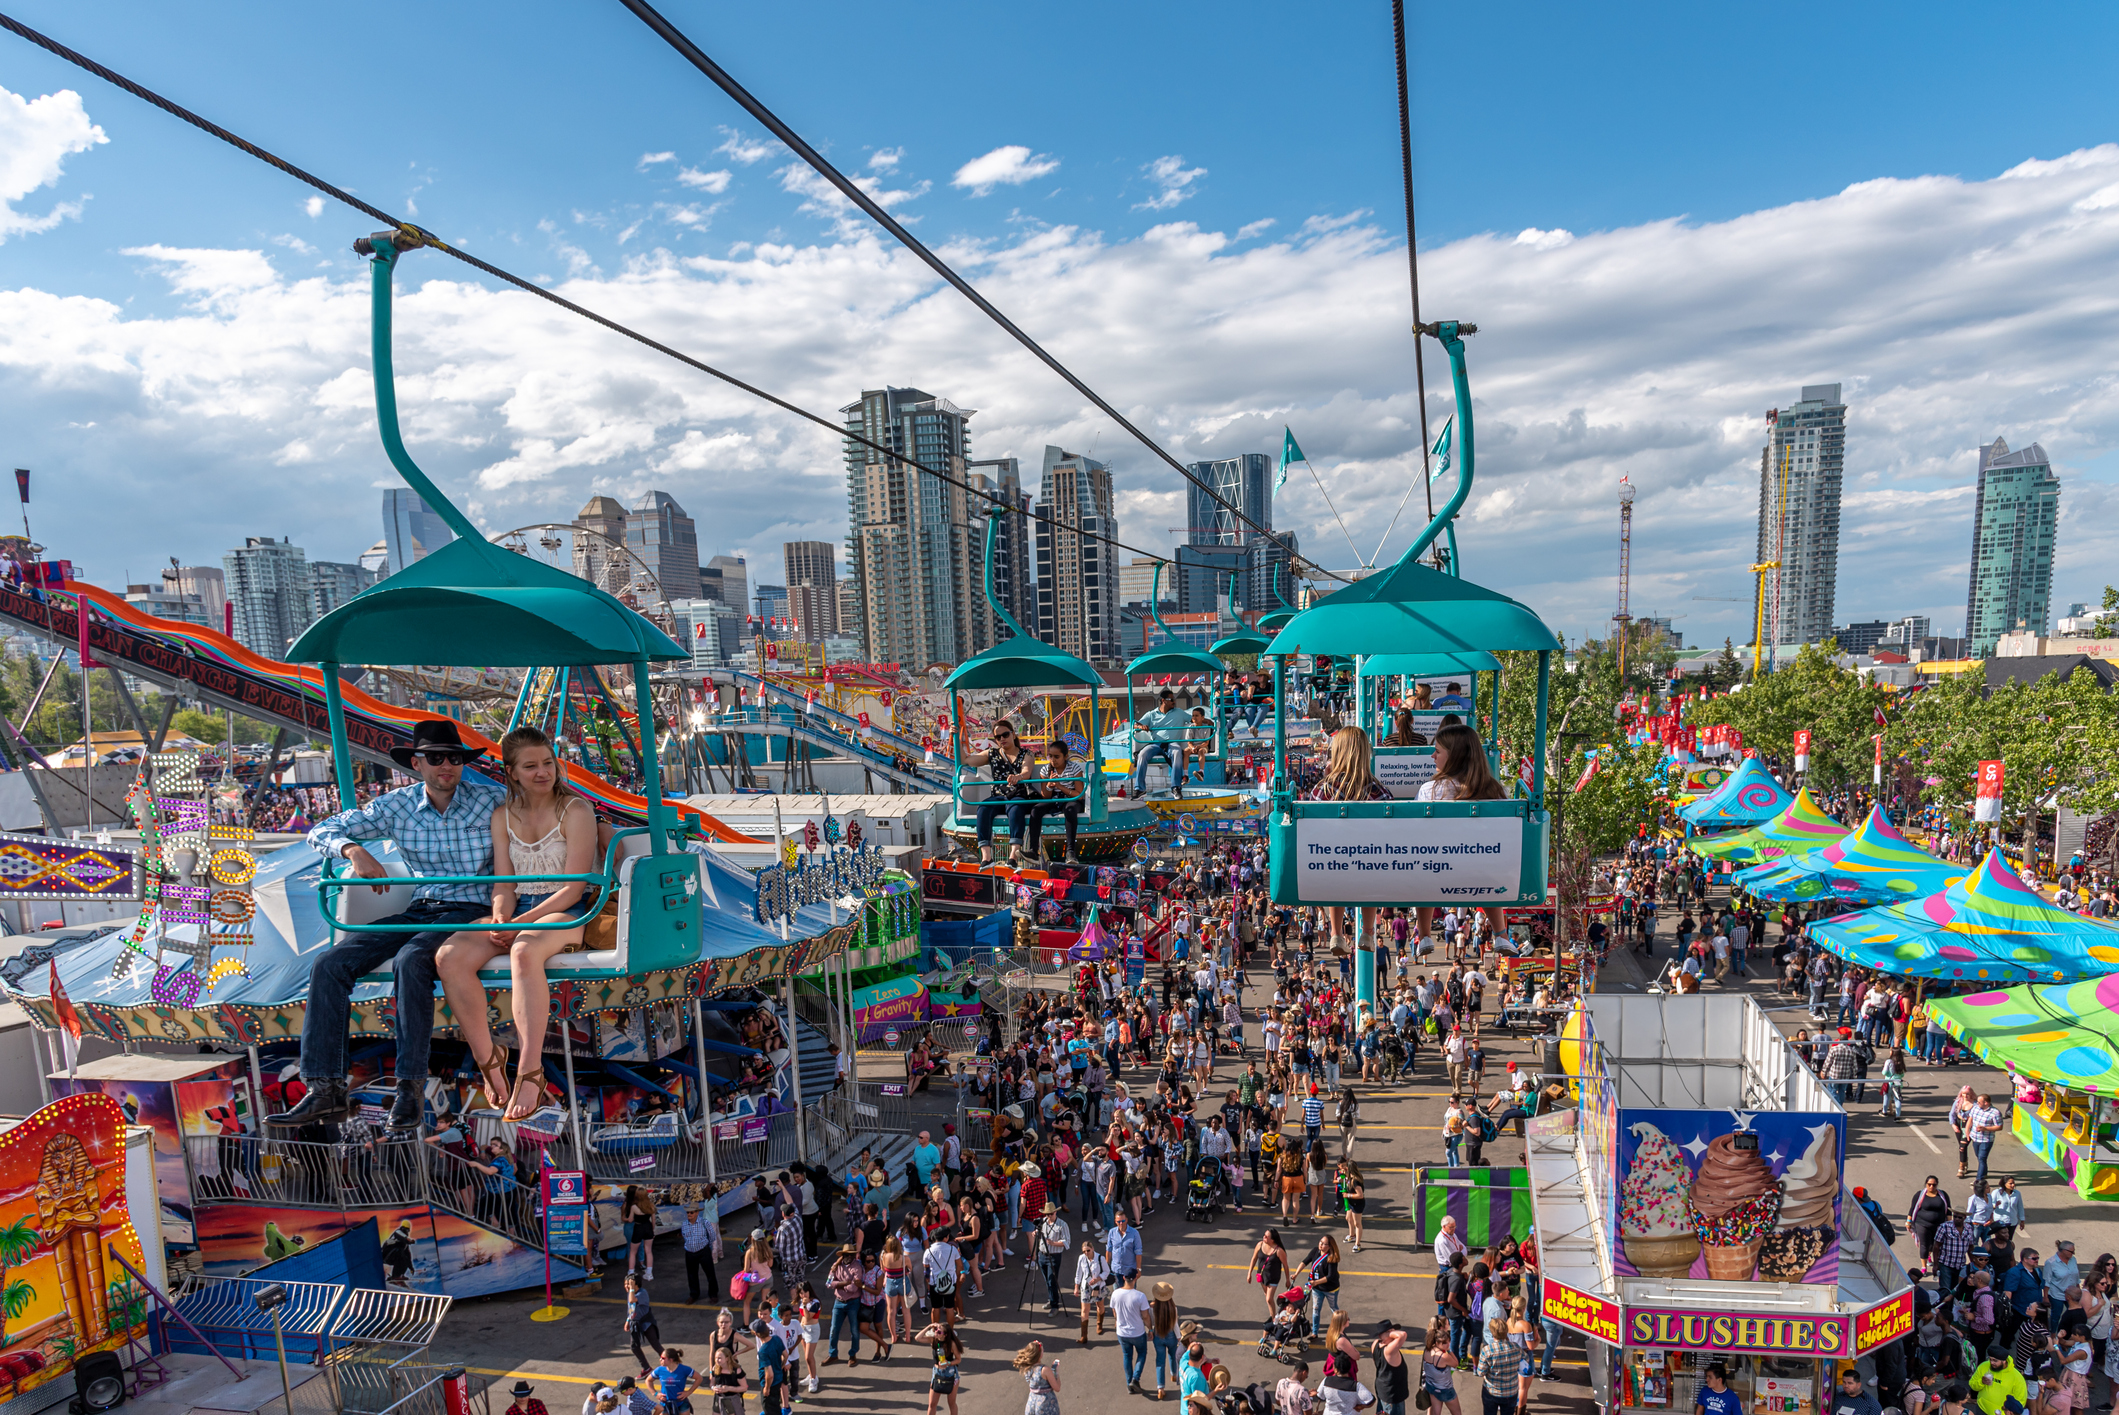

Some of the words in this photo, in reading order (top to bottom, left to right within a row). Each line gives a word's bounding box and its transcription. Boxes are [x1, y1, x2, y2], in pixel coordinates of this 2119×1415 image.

[88, 623, 134, 657] CAN
[138, 642, 237, 695] CHANGE
[867, 662, 900, 673] FOUR
[1986, 764, 1997, 781] CS
[1307, 843, 1331, 854] The
[1334, 843, 1382, 857] captain
[1385, 843, 1408, 854] has
[1410, 846, 1439, 854] now
[1441, 842, 1501, 854] switched
[1308, 861, 1324, 870] on
[1327, 859, 1349, 870] the
[1422, 859, 1453, 873] sign.
[1440, 886, 1494, 896] WESTJET
[1519, 892, 1538, 902] 36
[871, 987, 901, 1002] Zero
[873, 999, 913, 1020] Gravity
[883, 1084, 902, 1093] EXIT
[630, 1155, 654, 1168] ENTER
[561, 1179, 571, 1191] 6
[1559, 1286, 1603, 1316] HOT
[1545, 1298, 1618, 1341] CHOCOLATE
[1868, 1299, 1901, 1328] HOT
[1632, 1311, 1841, 1353] SLUSHIES
[1857, 1310, 1912, 1351] CHOCOLATE
